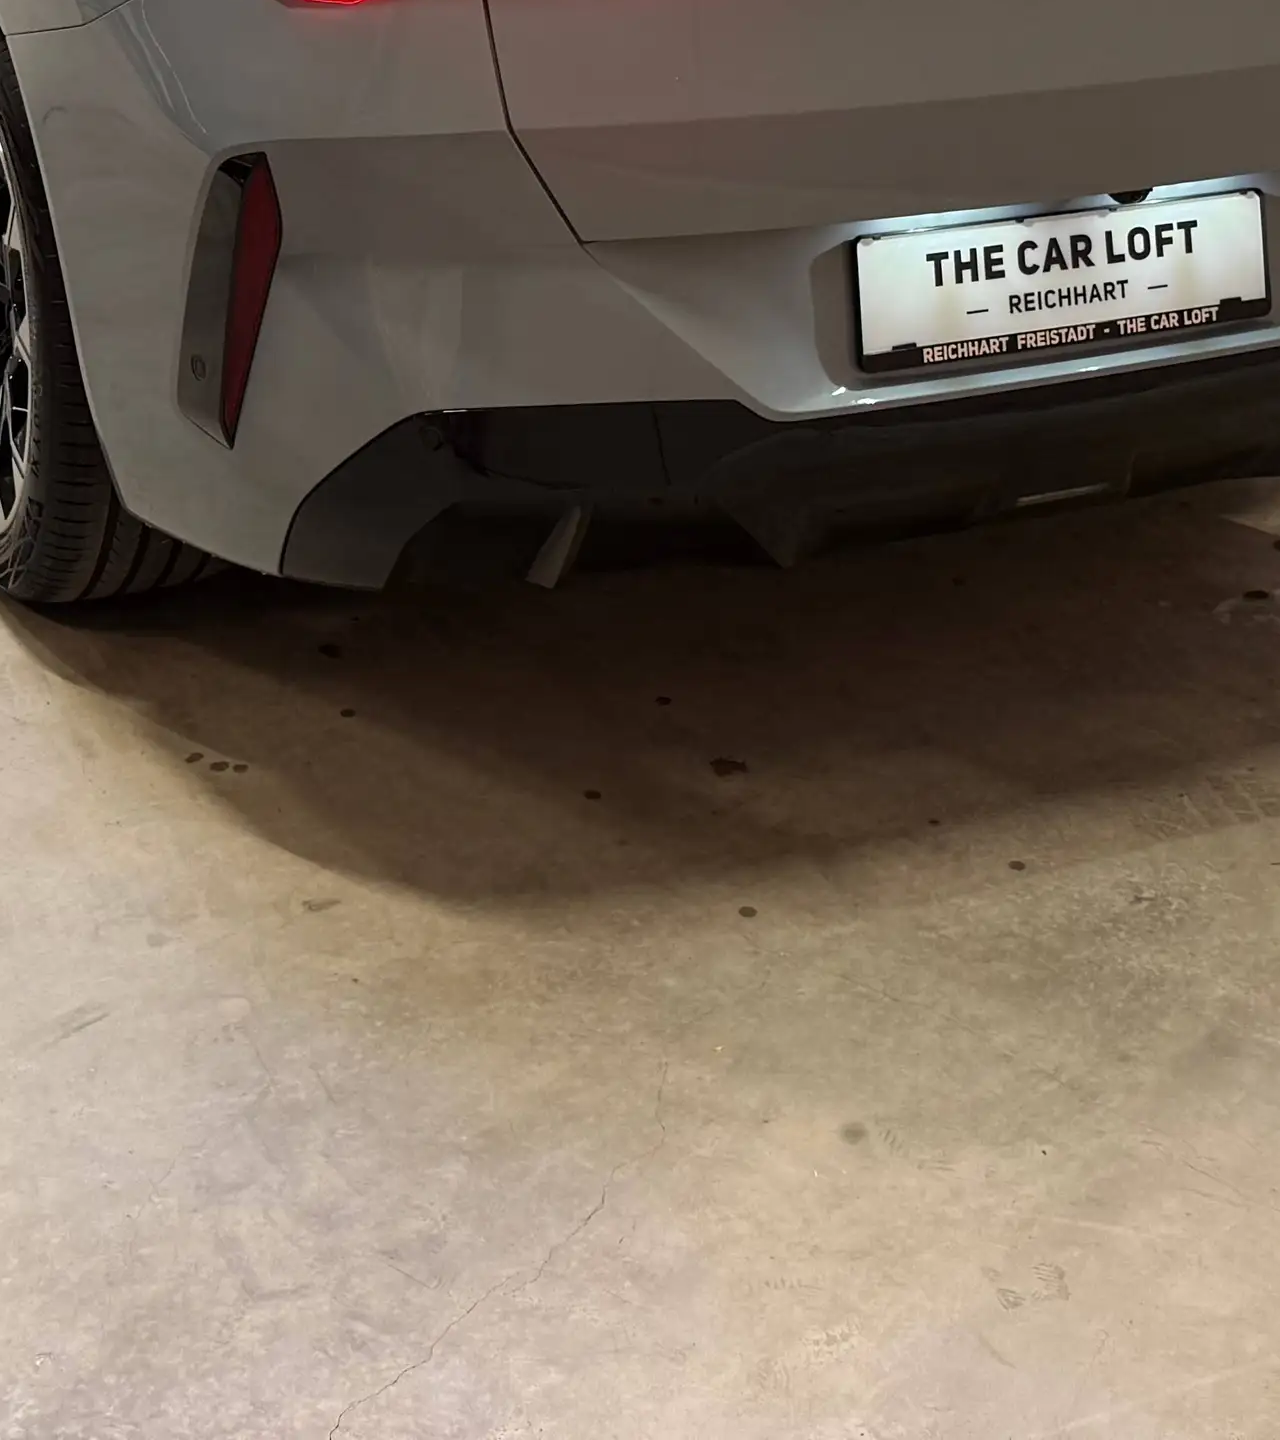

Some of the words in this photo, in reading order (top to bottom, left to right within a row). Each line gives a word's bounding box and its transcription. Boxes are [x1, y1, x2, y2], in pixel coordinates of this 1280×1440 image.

[926, 244, 1006, 287] THE
[1017, 234, 1096, 276] CAR
[1104, 219, 1198, 265] LOFT
[1008, 279, 1129, 314] REICHHART
[922, 336, 1009, 364] REICHHART
[1016, 324, 1096, 350] FREISTADT
[1116, 316, 1147, 335] THE
[1150, 312, 1180, 330] CAR
[1183, 306, 1219, 326] LOFT
